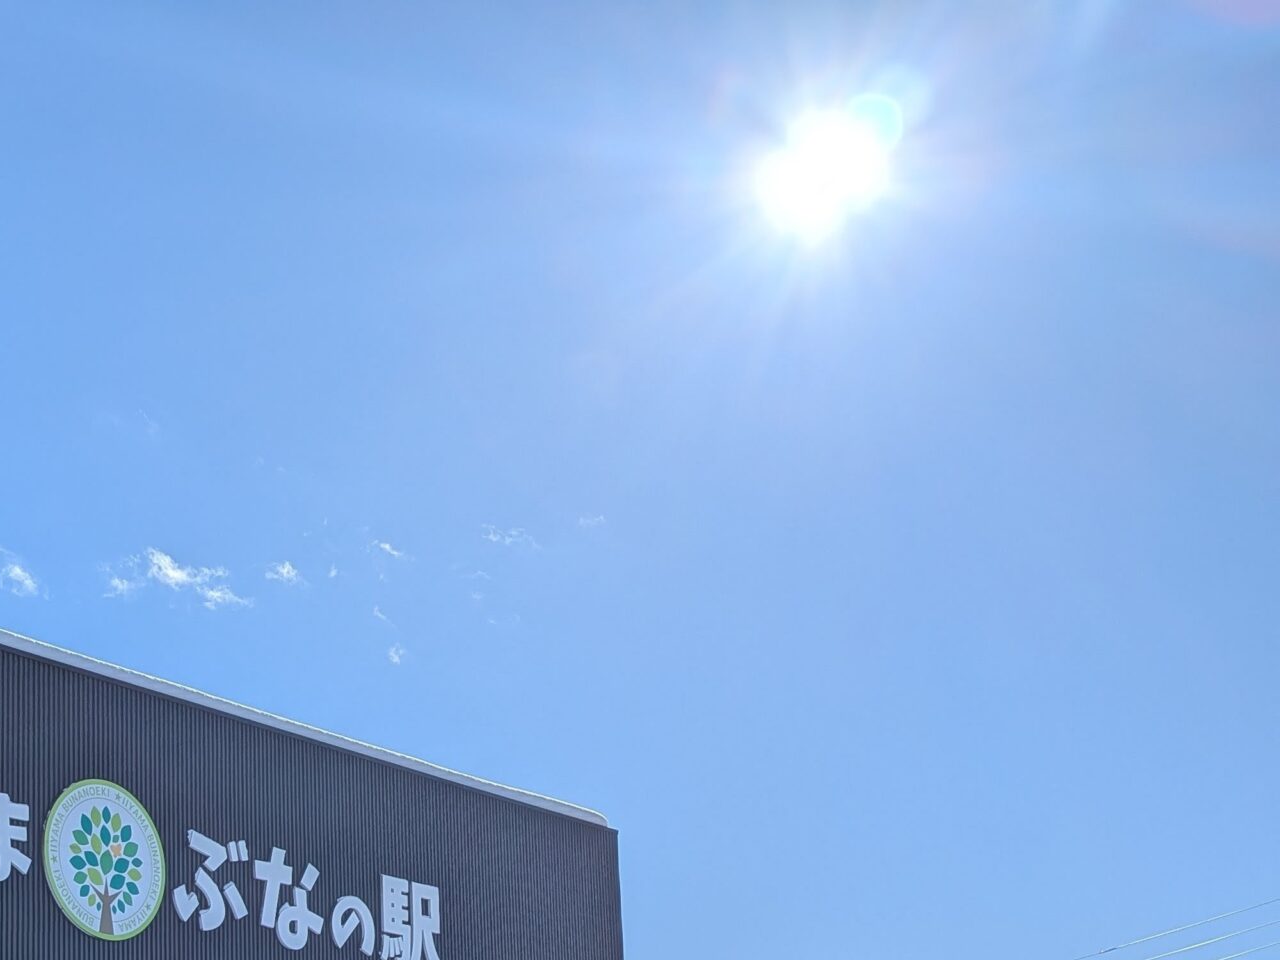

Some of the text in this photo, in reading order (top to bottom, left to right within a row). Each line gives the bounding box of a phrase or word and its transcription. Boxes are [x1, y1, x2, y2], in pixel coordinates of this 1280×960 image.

[50, 786, 111, 852] IIYAMA BUNANOEKI
[121, 798, 161, 900] IIYAMA BUNANOEKI
[53, 869, 95, 926] BUNANOEKI
